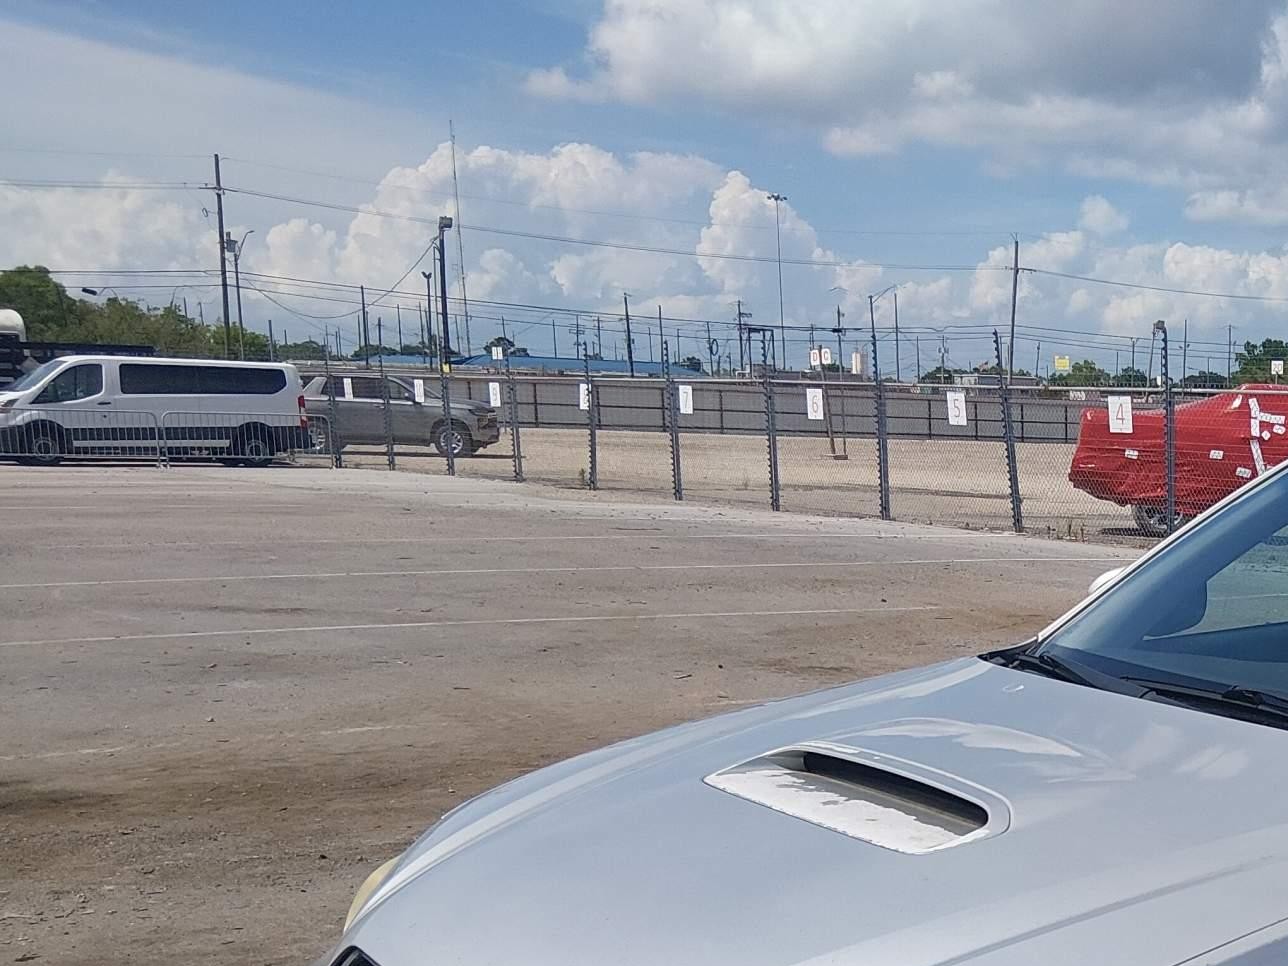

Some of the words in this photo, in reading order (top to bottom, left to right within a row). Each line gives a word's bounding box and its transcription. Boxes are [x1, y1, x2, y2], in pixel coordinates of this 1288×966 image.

[682, 391, 689, 409] 7
[811, 394, 819, 414] 6
[953, 400, 961, 418] 5
[1115, 403, 1126, 426] 4
